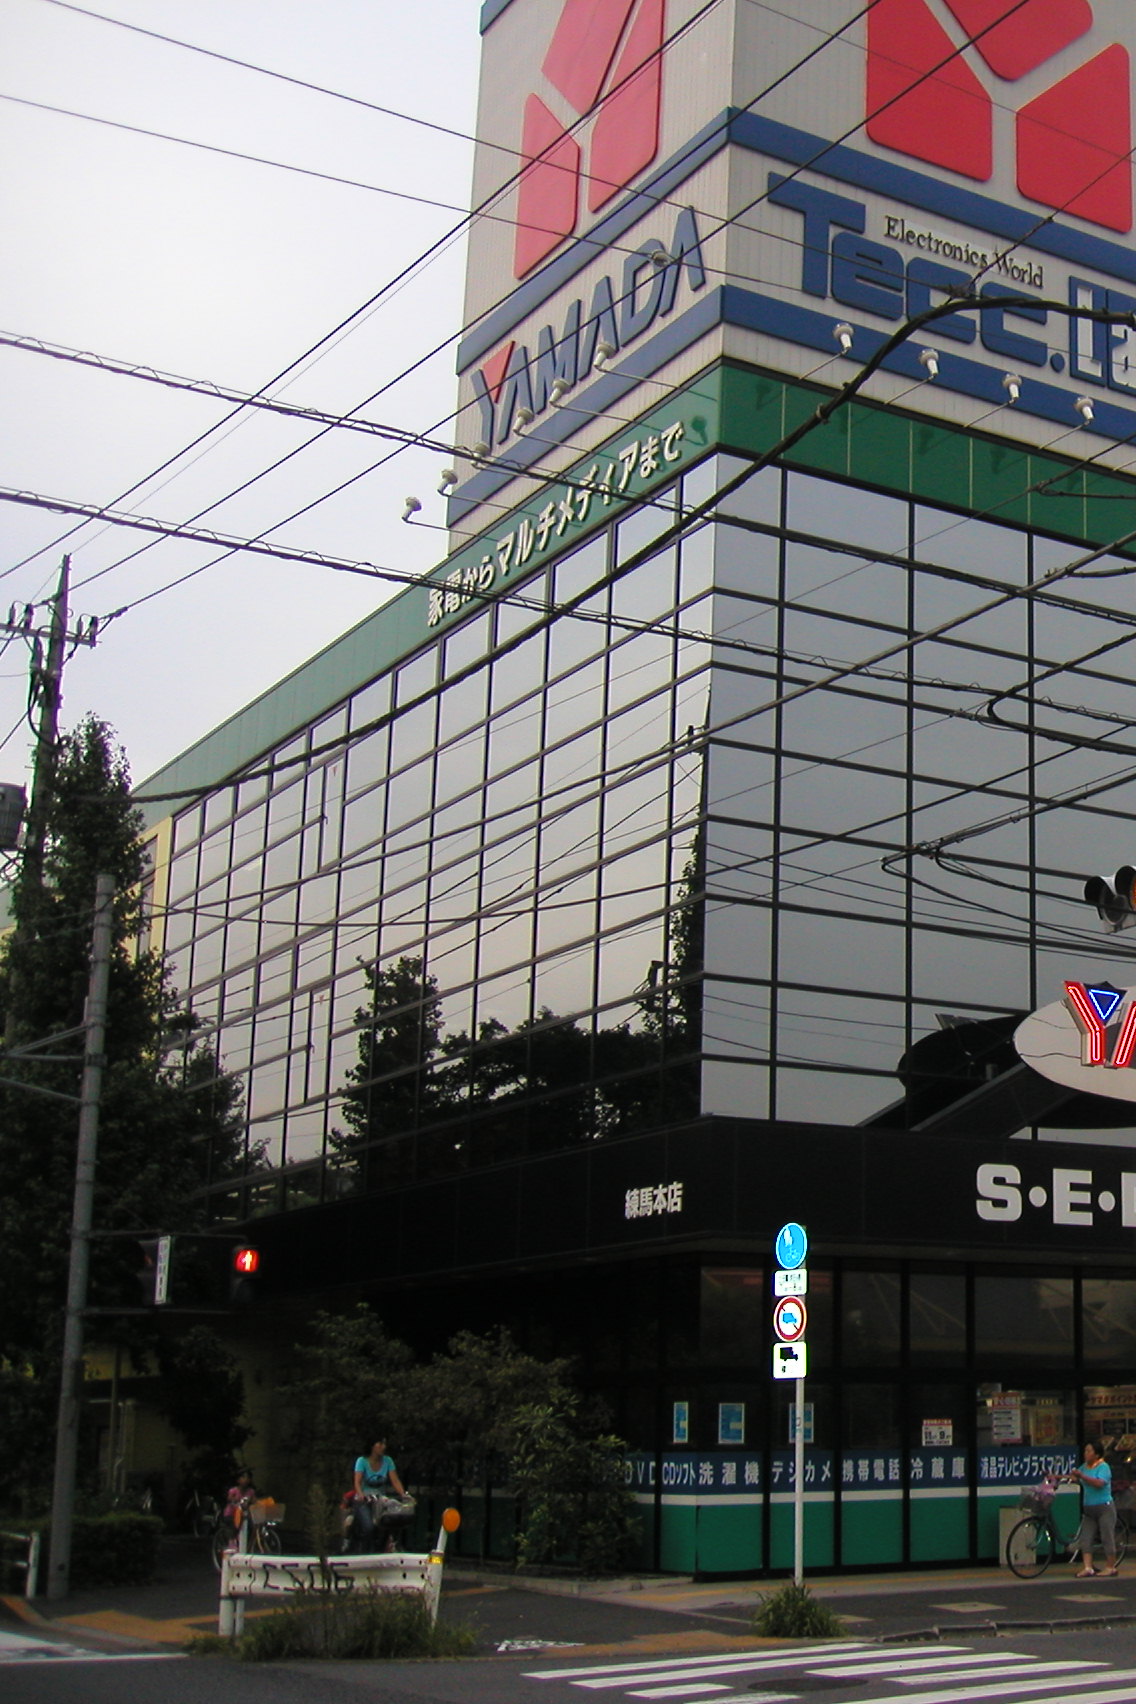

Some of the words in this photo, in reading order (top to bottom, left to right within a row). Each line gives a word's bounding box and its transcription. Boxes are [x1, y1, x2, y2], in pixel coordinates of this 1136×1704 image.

[883, 214, 989, 269] Electronics
[993, 246, 1044, 290] World
[470, 205, 707, 456] YAMADA
[428, 421, 685, 627] 家電からマルチメディアまで
[625, 1181, 684, 1219] 練馬本店
[698, 1461, 760, 1486] 洗濯機
[842, 1457, 901, 1483] 携帯電話
[910, 1456, 966, 1480] 冷蔵庫
